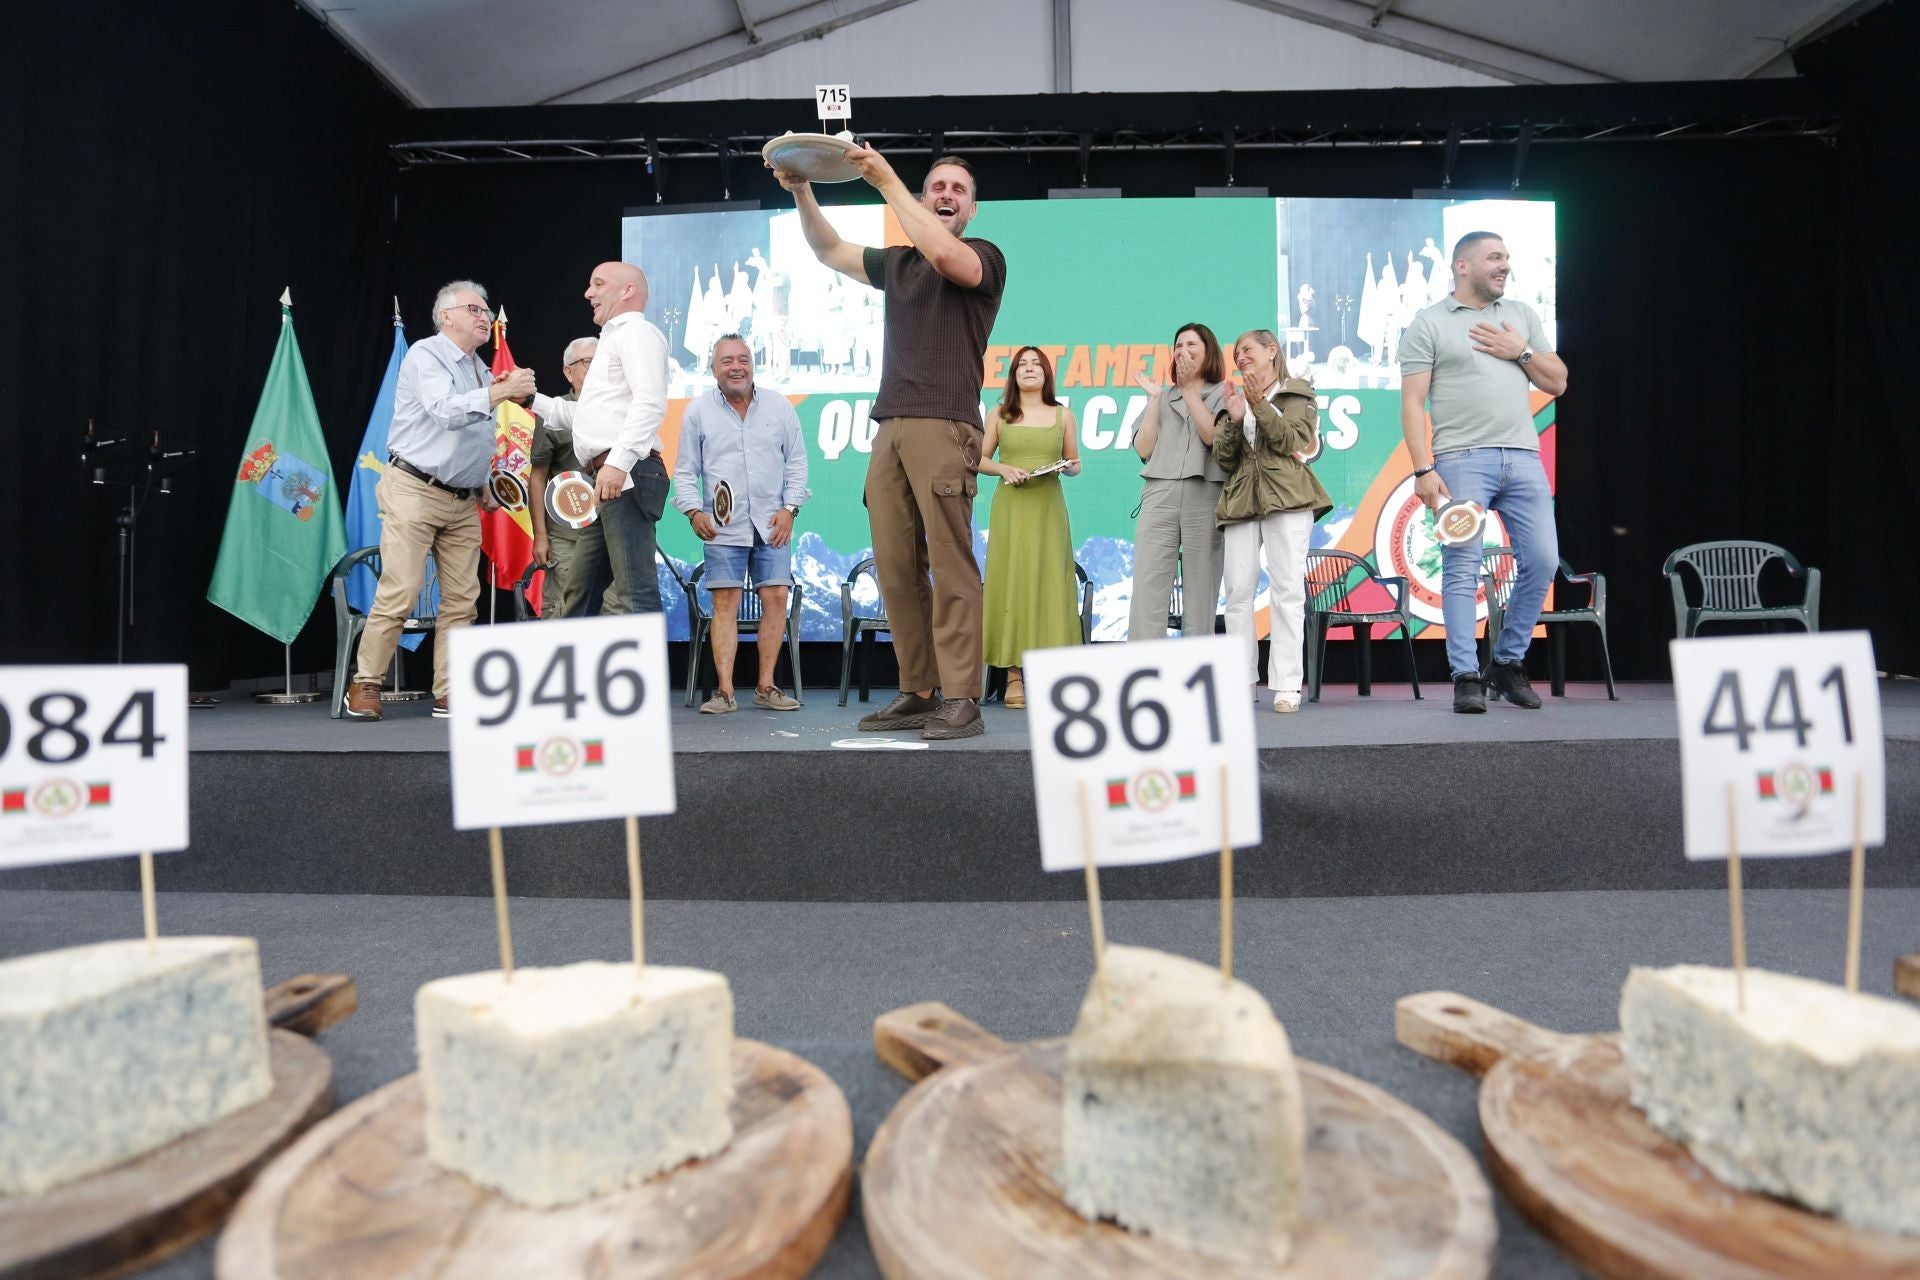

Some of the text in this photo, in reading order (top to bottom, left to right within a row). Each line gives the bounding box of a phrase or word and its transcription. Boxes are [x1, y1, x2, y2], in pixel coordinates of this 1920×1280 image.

[819, 88, 848, 103] 715
[1406, 524, 1415, 564] CONSEJO
[473, 640, 646, 727] 946
[1050, 663, 1222, 759] 861
[1703, 665, 1854, 752] 441
